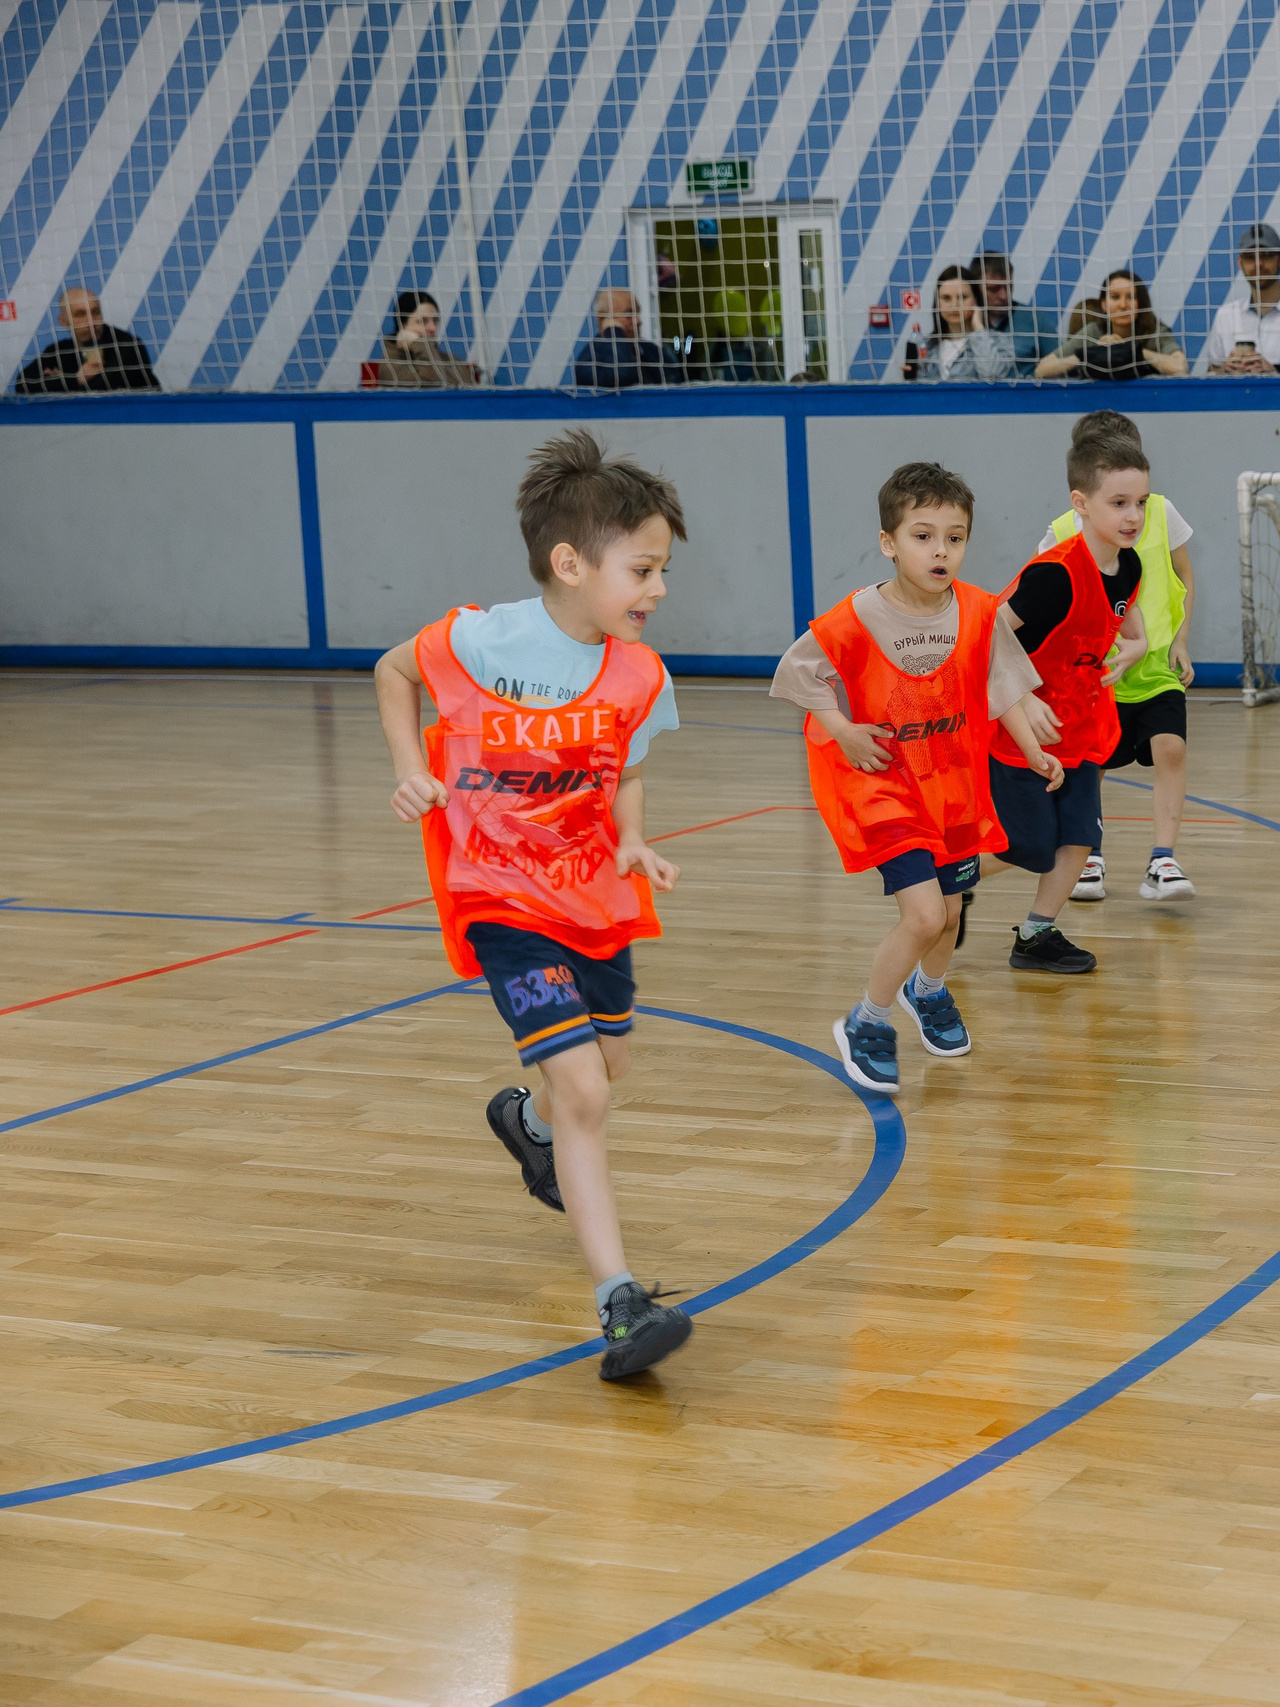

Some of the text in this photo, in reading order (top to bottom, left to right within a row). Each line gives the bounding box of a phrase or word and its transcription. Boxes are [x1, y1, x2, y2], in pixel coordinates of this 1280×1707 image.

[894, 633, 926, 650] БУРЫЙ
[494, 677, 524, 701] ON
[531, 683, 552, 698] THE
[486, 709, 612, 748] SKATE
